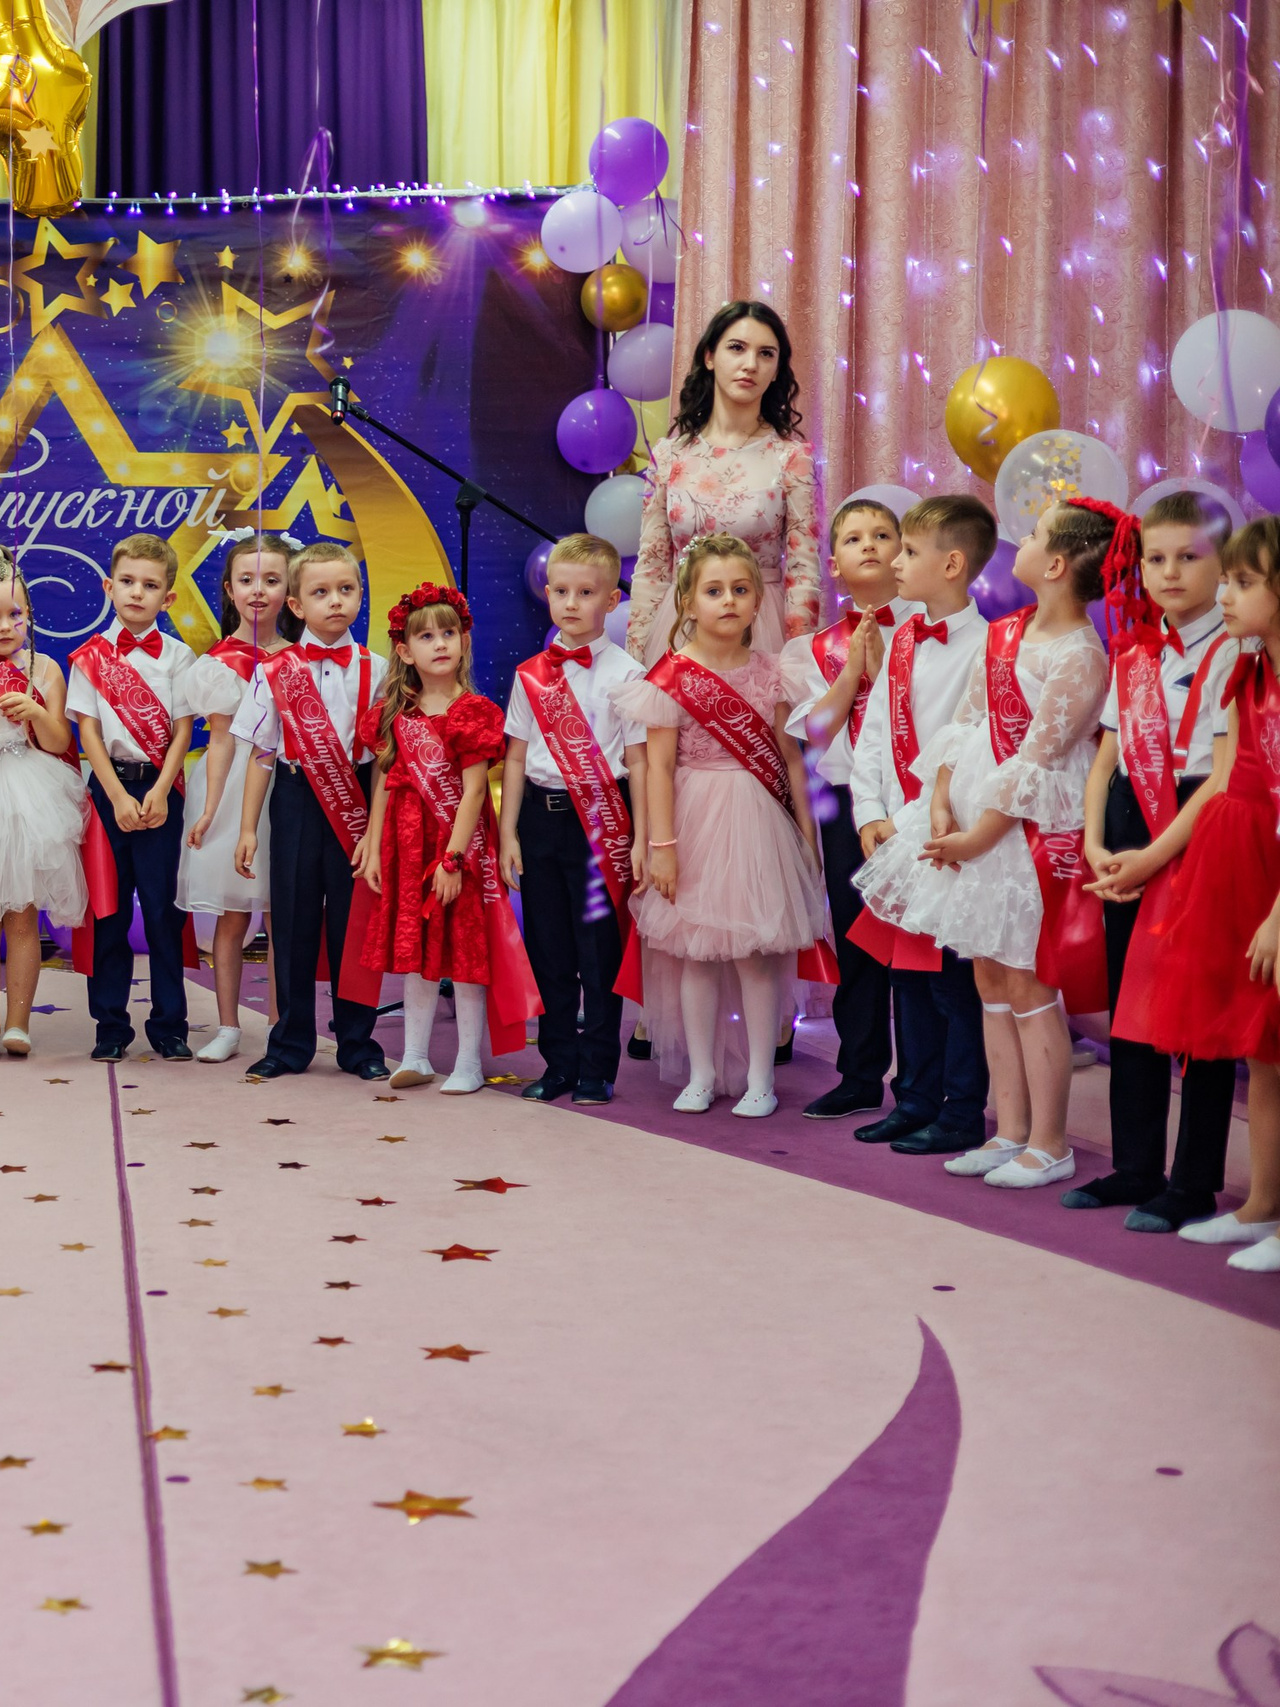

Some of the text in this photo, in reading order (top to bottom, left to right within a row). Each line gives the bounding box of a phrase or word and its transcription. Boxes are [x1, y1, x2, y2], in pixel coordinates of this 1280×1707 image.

[113, 704, 162, 760] детского сада
[281, 710, 306, 750] детского
[304, 754, 318, 775] сада
[705, 720, 746, 755] детского
[746, 754, 764, 774] сада
[990, 711, 1007, 759] детского
[297, 695, 368, 843] Выпускник 202
[408, 761, 451, 823] детского сада
[544, 732, 572, 772] детского
[569, 774, 583, 796] сада
[1131, 759, 1147, 786] сада
[560, 715, 632, 883] Выпускник 2024
[1045, 835, 1082, 880] 024
